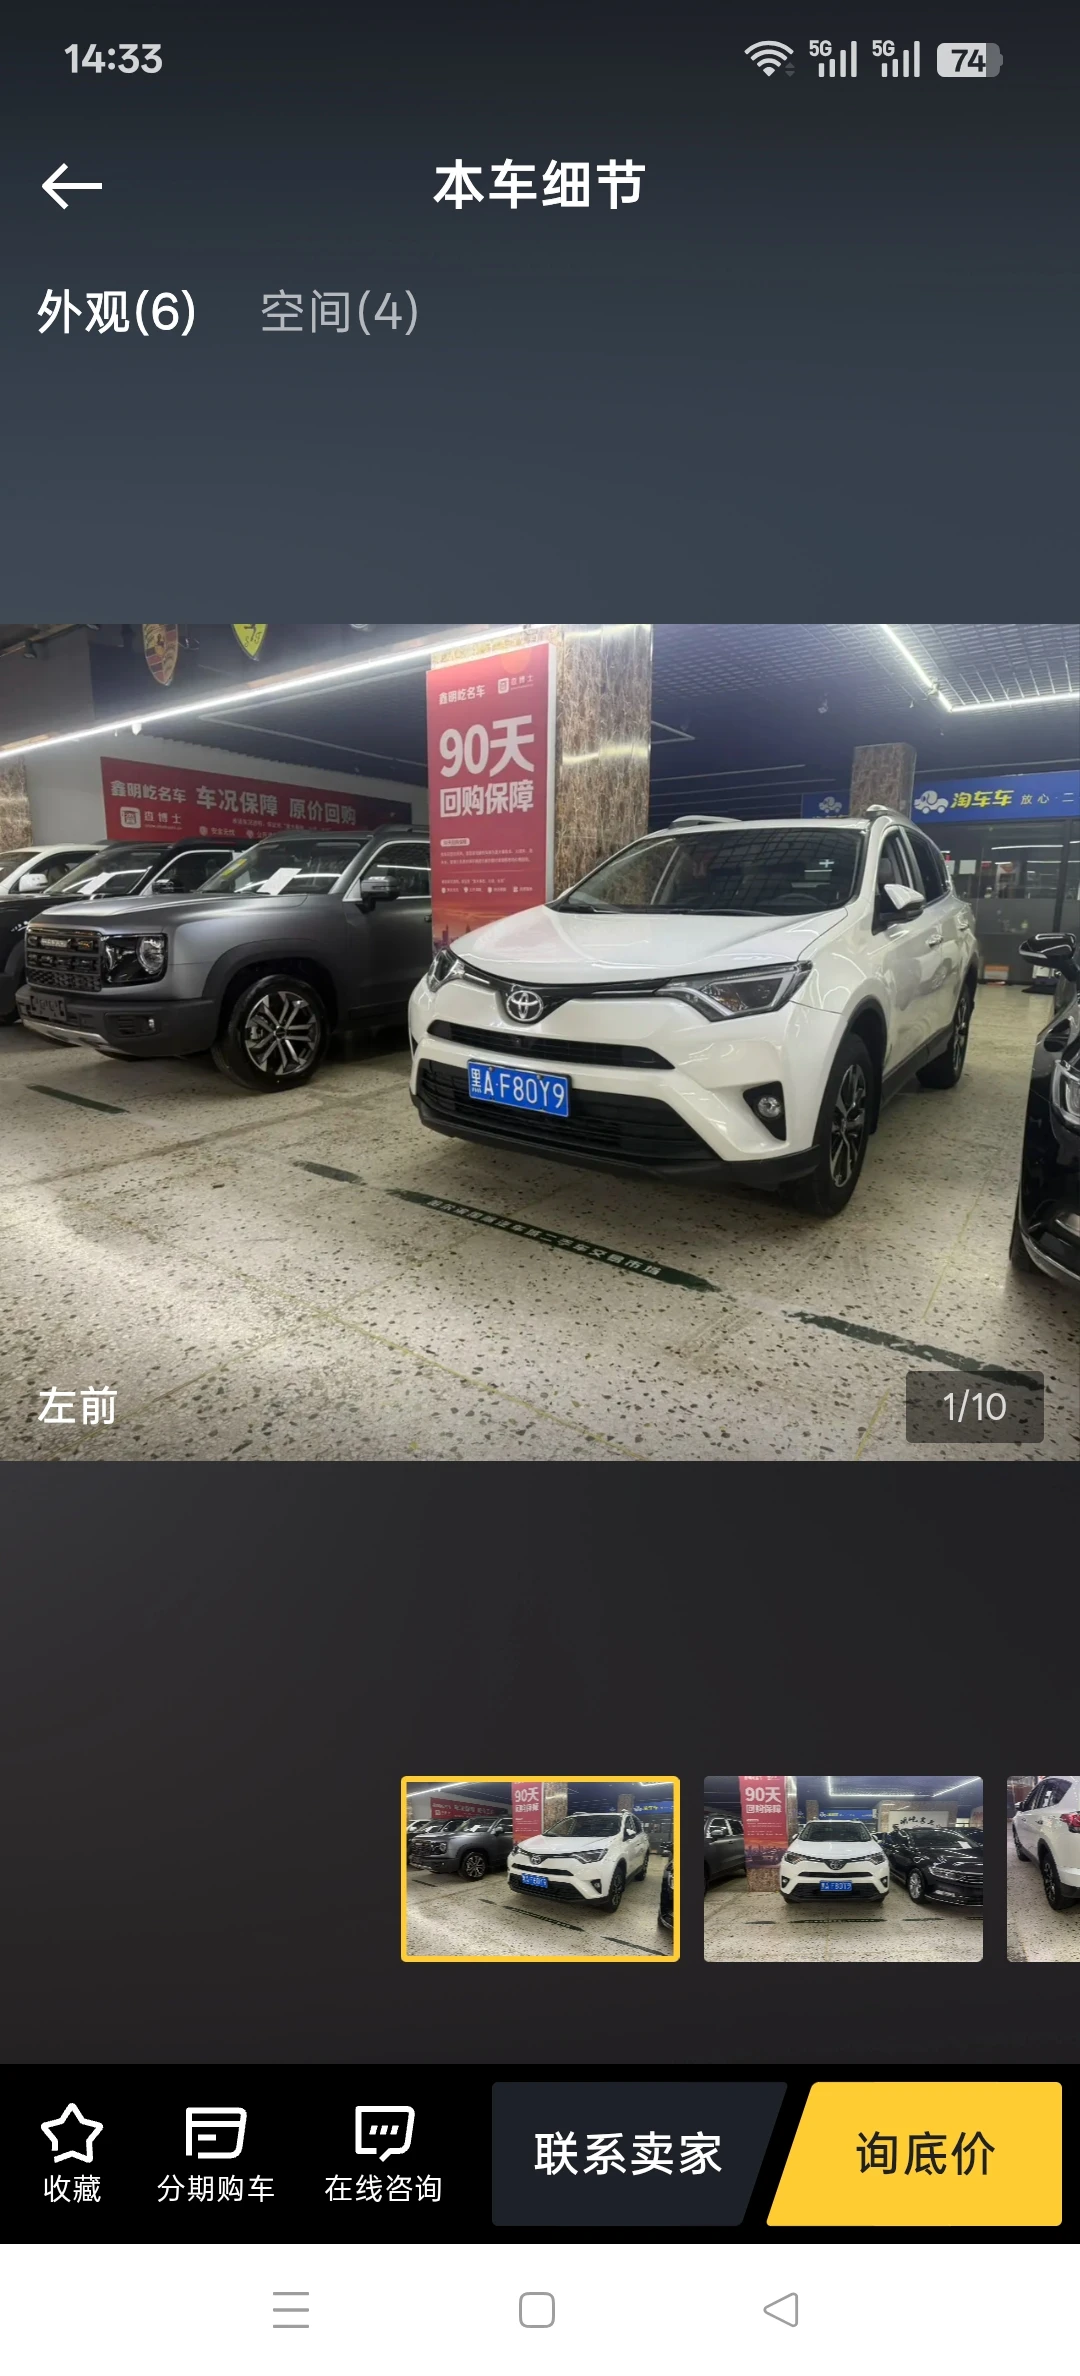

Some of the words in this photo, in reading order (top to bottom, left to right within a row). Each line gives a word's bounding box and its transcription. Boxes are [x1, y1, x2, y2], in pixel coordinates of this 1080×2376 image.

[64, 43, 163, 74] 14:33
[809, 39, 833, 57] 5G
[872, 39, 896, 57] 5G
[950, 48, 987, 73] 74
[432, 157, 646, 210] 本车细节
[36, 288, 195, 337] 外观(6)
[261, 288, 418, 336] 空间(4)
[440, 714, 534, 777] 90天
[110, 780, 187, 804] 鑫明屹名车
[196, 785, 278, 817] 车况保障
[289, 797, 356, 826] 原价回购
[440, 779, 534, 818] 回购保障
[950, 789, 1015, 808] 淘车车
[745, 1787, 782, 1803] 90天
[534, 2130, 723, 2176] 联系卖家
[856, 2130, 996, 2176] 询底价
[43, 2174, 102, 2204] 收藏
[157, 2173, 275, 2203] 分期购车
[324, 2173, 442, 2203] 在线咨询
